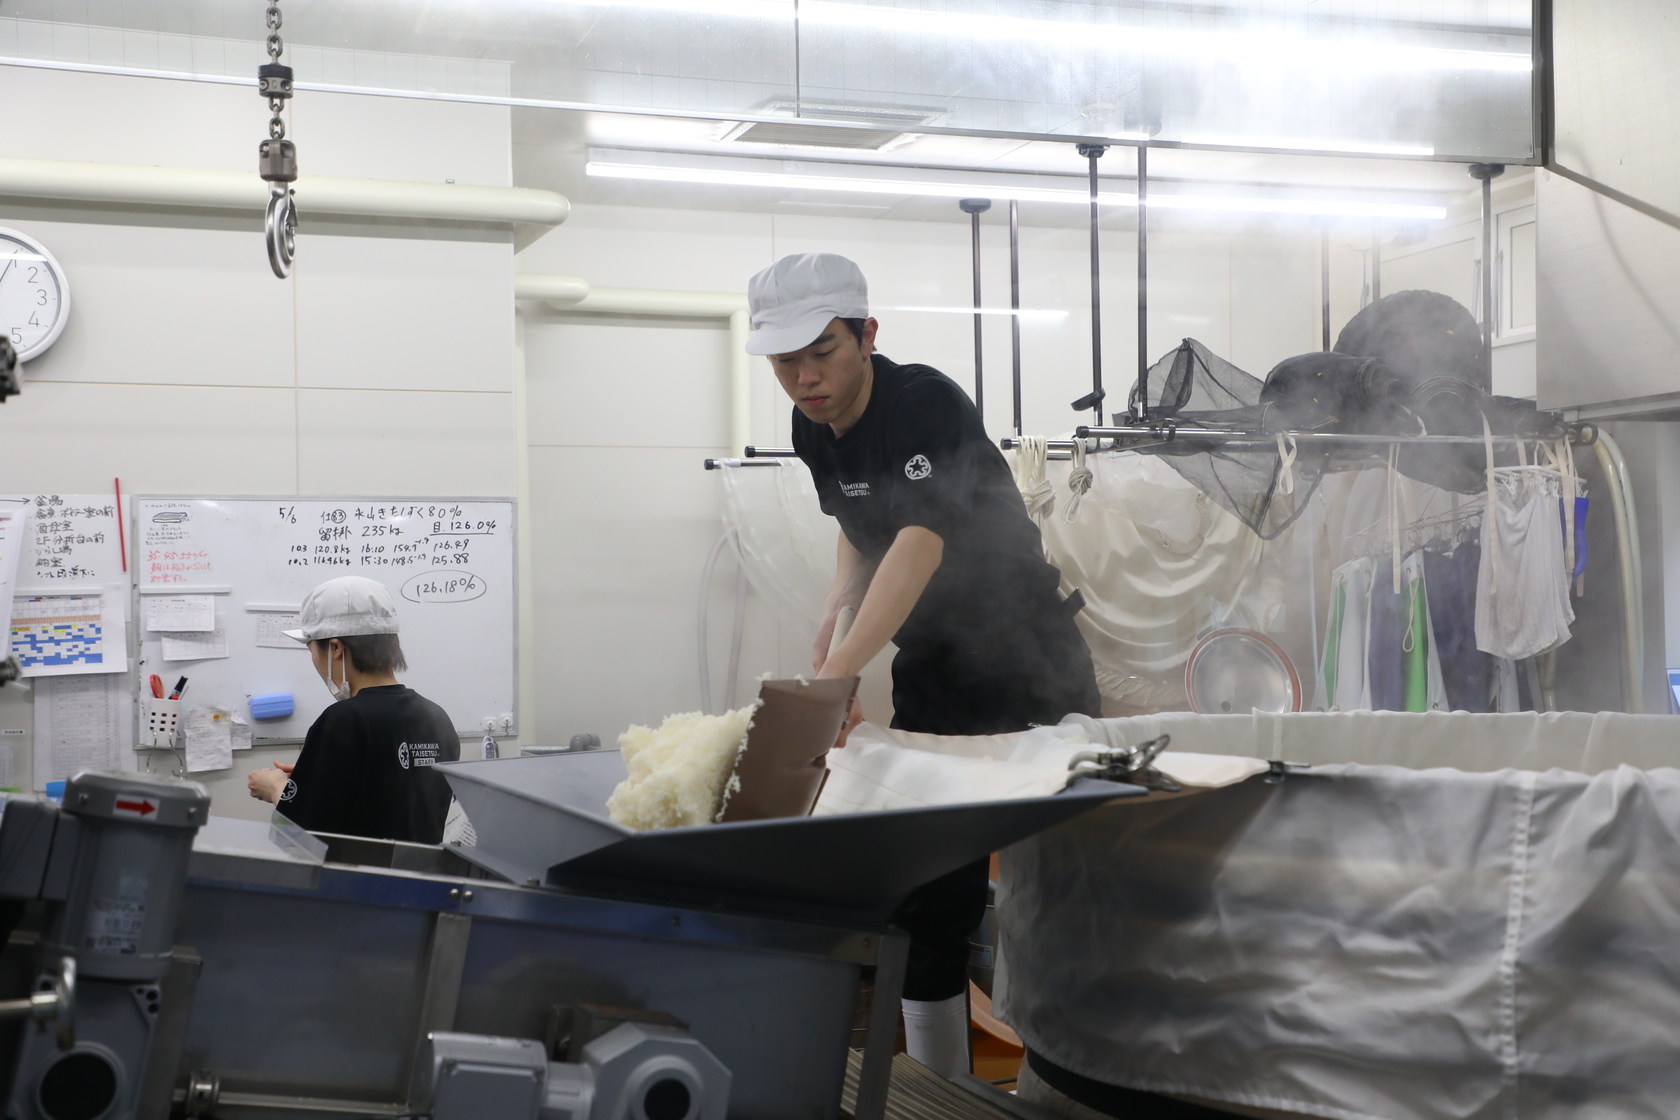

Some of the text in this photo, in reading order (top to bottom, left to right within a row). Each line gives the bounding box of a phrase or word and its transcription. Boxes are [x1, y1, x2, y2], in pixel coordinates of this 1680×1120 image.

[27, 266, 38, 283] 2
[36, 289, 48, 306] 3
[28, 311, 40, 327] 4
[11, 327, 22, 344] 5
[279, 506, 297, 524] 5/6
[361, 543, 385, 553] 16:10
[361, 556, 388, 566] 15:30
[416, 575, 476, 598] 126.18%
